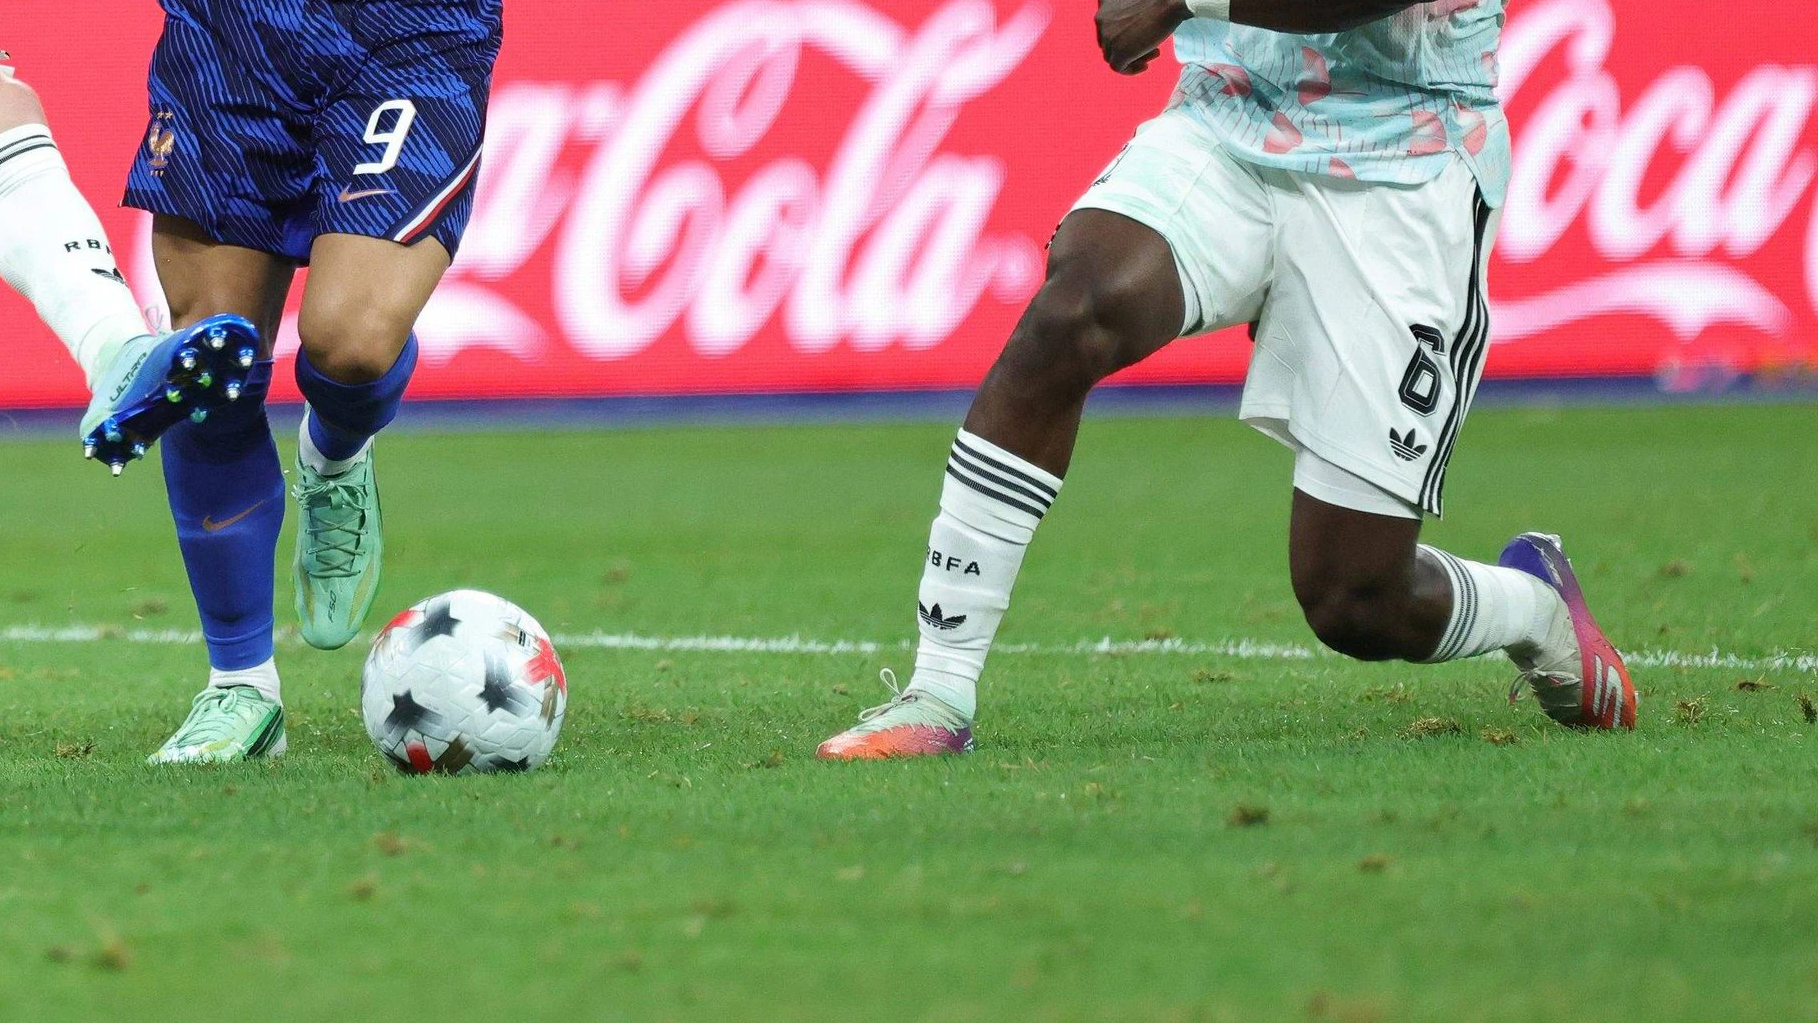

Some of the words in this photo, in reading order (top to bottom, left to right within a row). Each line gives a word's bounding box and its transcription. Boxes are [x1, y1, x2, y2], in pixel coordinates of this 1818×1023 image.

[352, 99, 417, 175] 9
[64, 239, 111, 254] RB
[109, 351, 147, 402] ULTRA
[1398, 323, 1445, 416] 6
